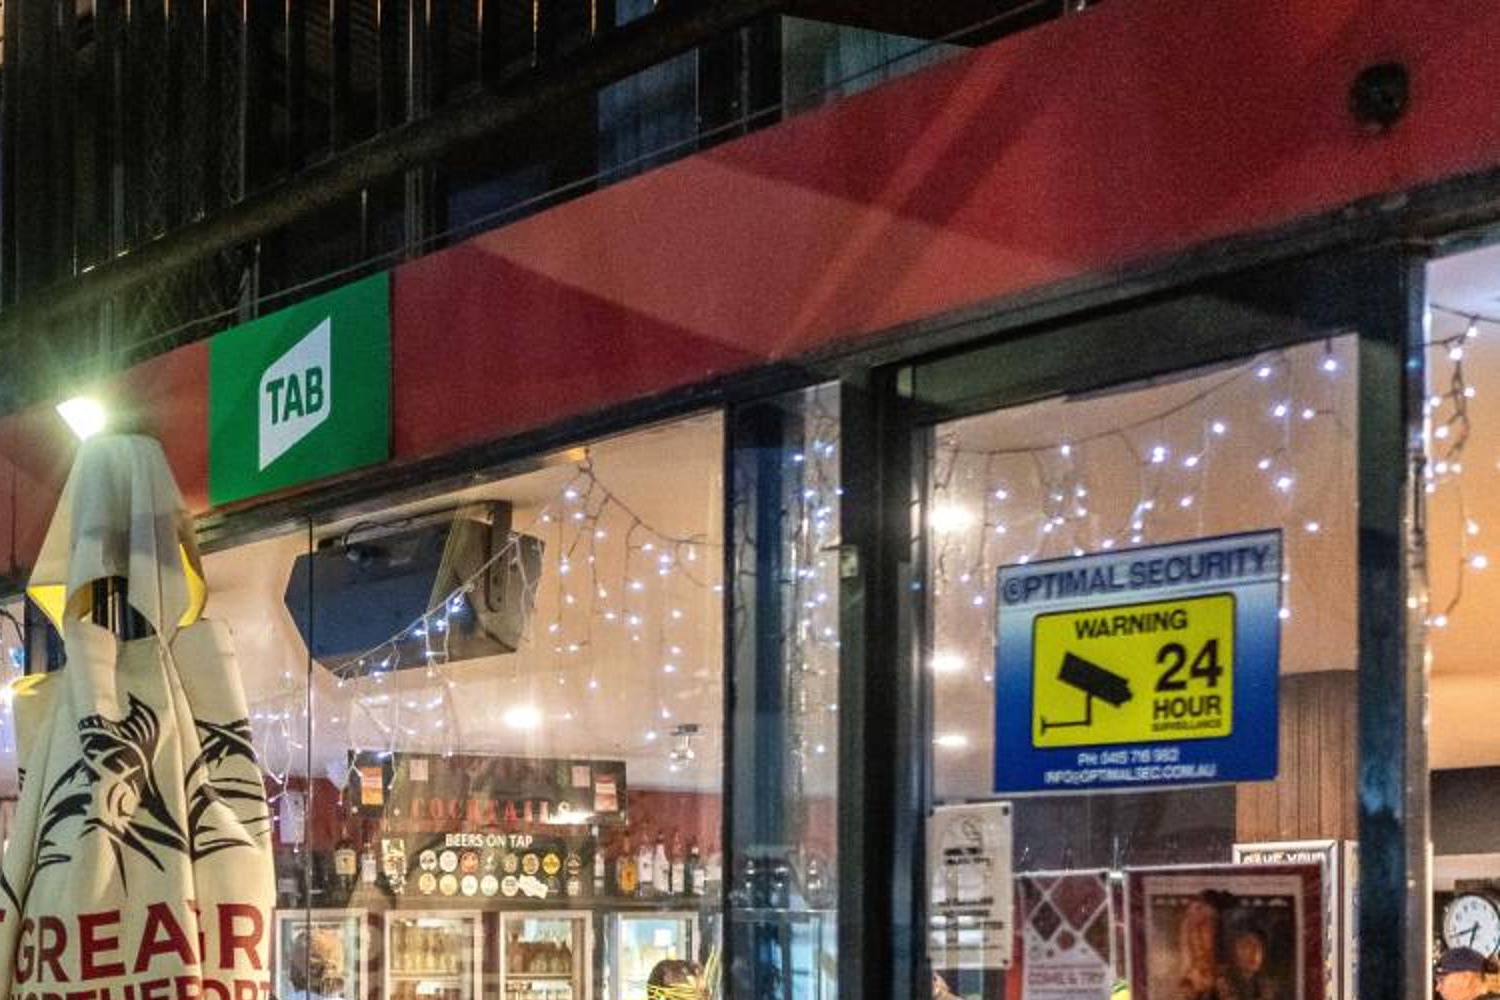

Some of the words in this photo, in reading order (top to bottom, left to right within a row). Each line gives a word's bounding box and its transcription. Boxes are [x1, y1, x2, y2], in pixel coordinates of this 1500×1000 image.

[265, 366, 324, 425] TAB
[1129, 546, 1270, 588] SECURITY
[1075, 609, 1188, 639] WARNING
[1155, 639, 1223, 692] 24
[1152, 695, 1222, 720] HOUR
[445, 833, 484, 848] BEERS
[486, 833, 506, 848] ON
[509, 834, 533, 849] TAP
[15, 901, 200, 984] GREA
